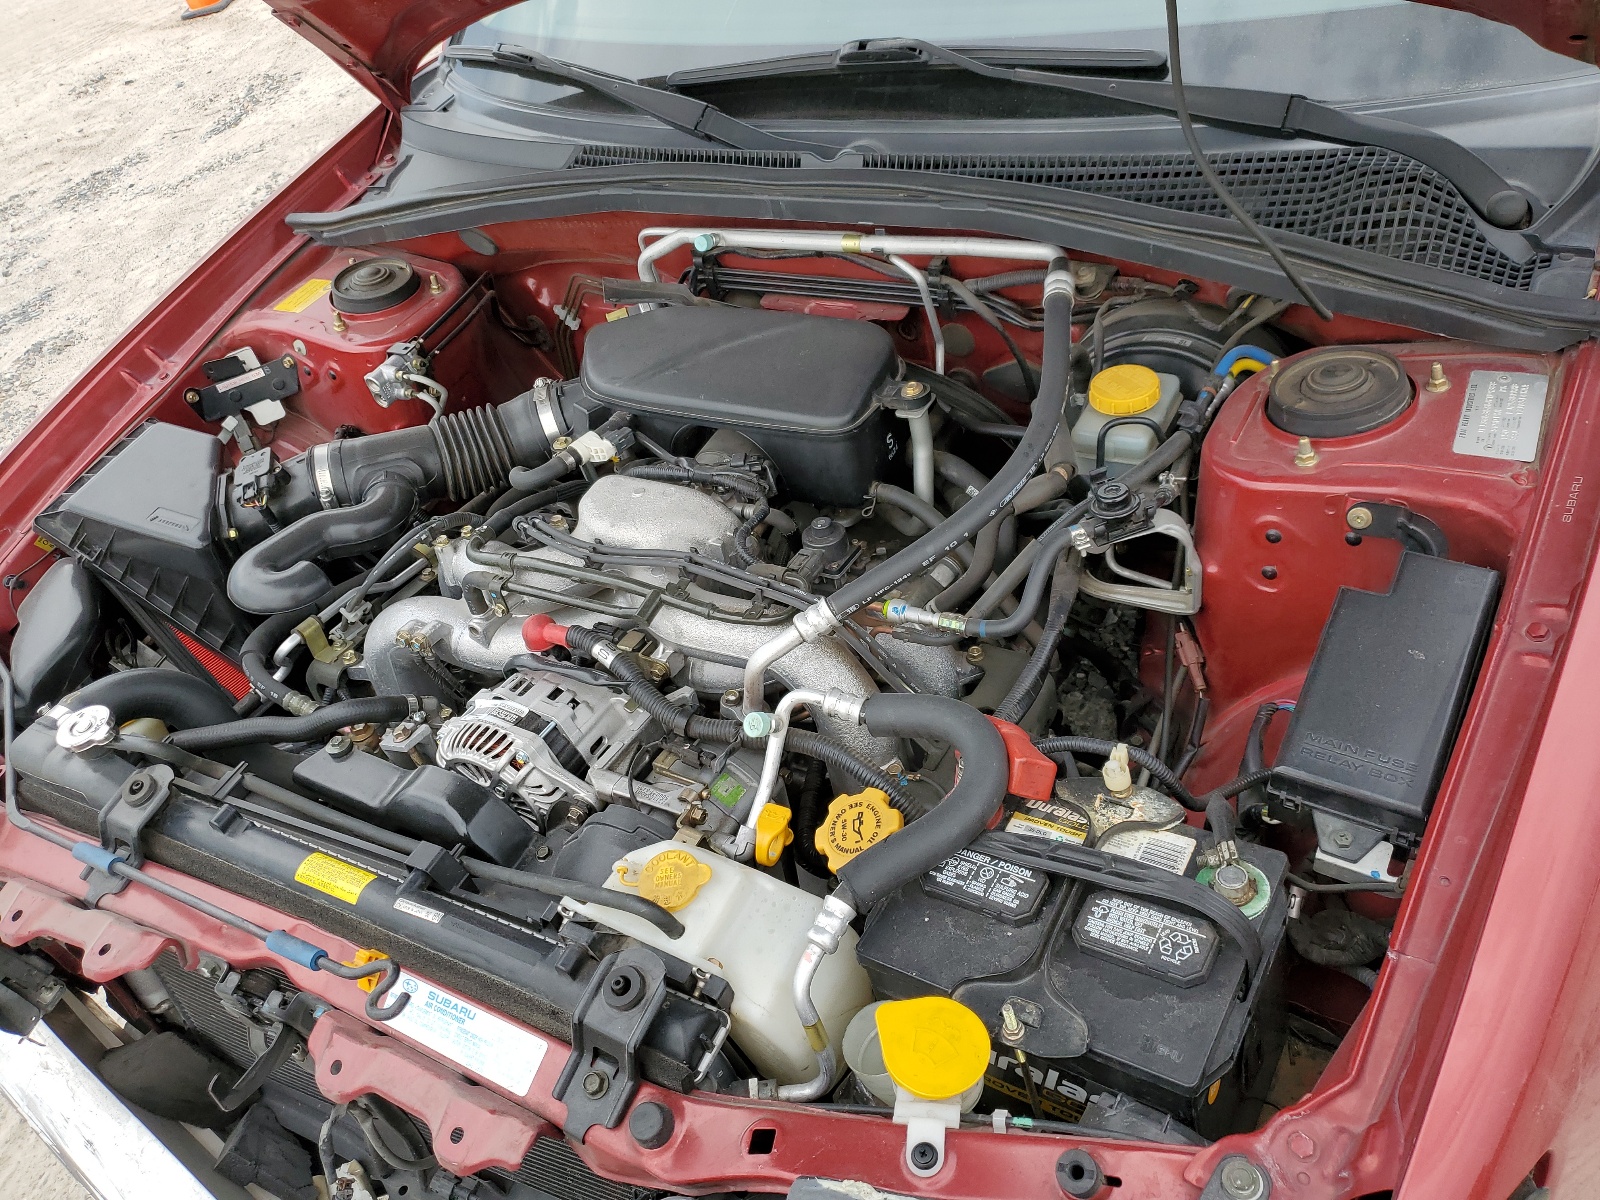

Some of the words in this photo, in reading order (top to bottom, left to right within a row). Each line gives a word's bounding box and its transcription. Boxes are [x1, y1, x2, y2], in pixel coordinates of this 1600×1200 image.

[1562, 476, 1584, 523] SUBARU
[1305, 732, 1359, 755] MAIN
[1364, 749, 1419, 772] FUSE
[1300, 747, 1363, 772] RELAY
[1368, 768, 1413, 788] BOX
[848, 802, 863, 810] SEE
[866, 803, 881, 829] ENGINE
[1024, 817, 1054, 828] PROVEN
[1056, 827, 1083, 837] TOUGH
[867, 831, 878, 844] OIL
[835, 843, 864, 854] MANUAL
[645, 853, 696, 873] COOLANT
[999, 861, 1032, 877] POISON
[654, 881, 682, 889] MANUAL
[655, 873, 681, 882] OWNERS
[424, 1001, 433, 1012] AIR
[433, 1004, 466, 1025] CONDITIONER
[427, 991, 477, 1021] SUBARU
